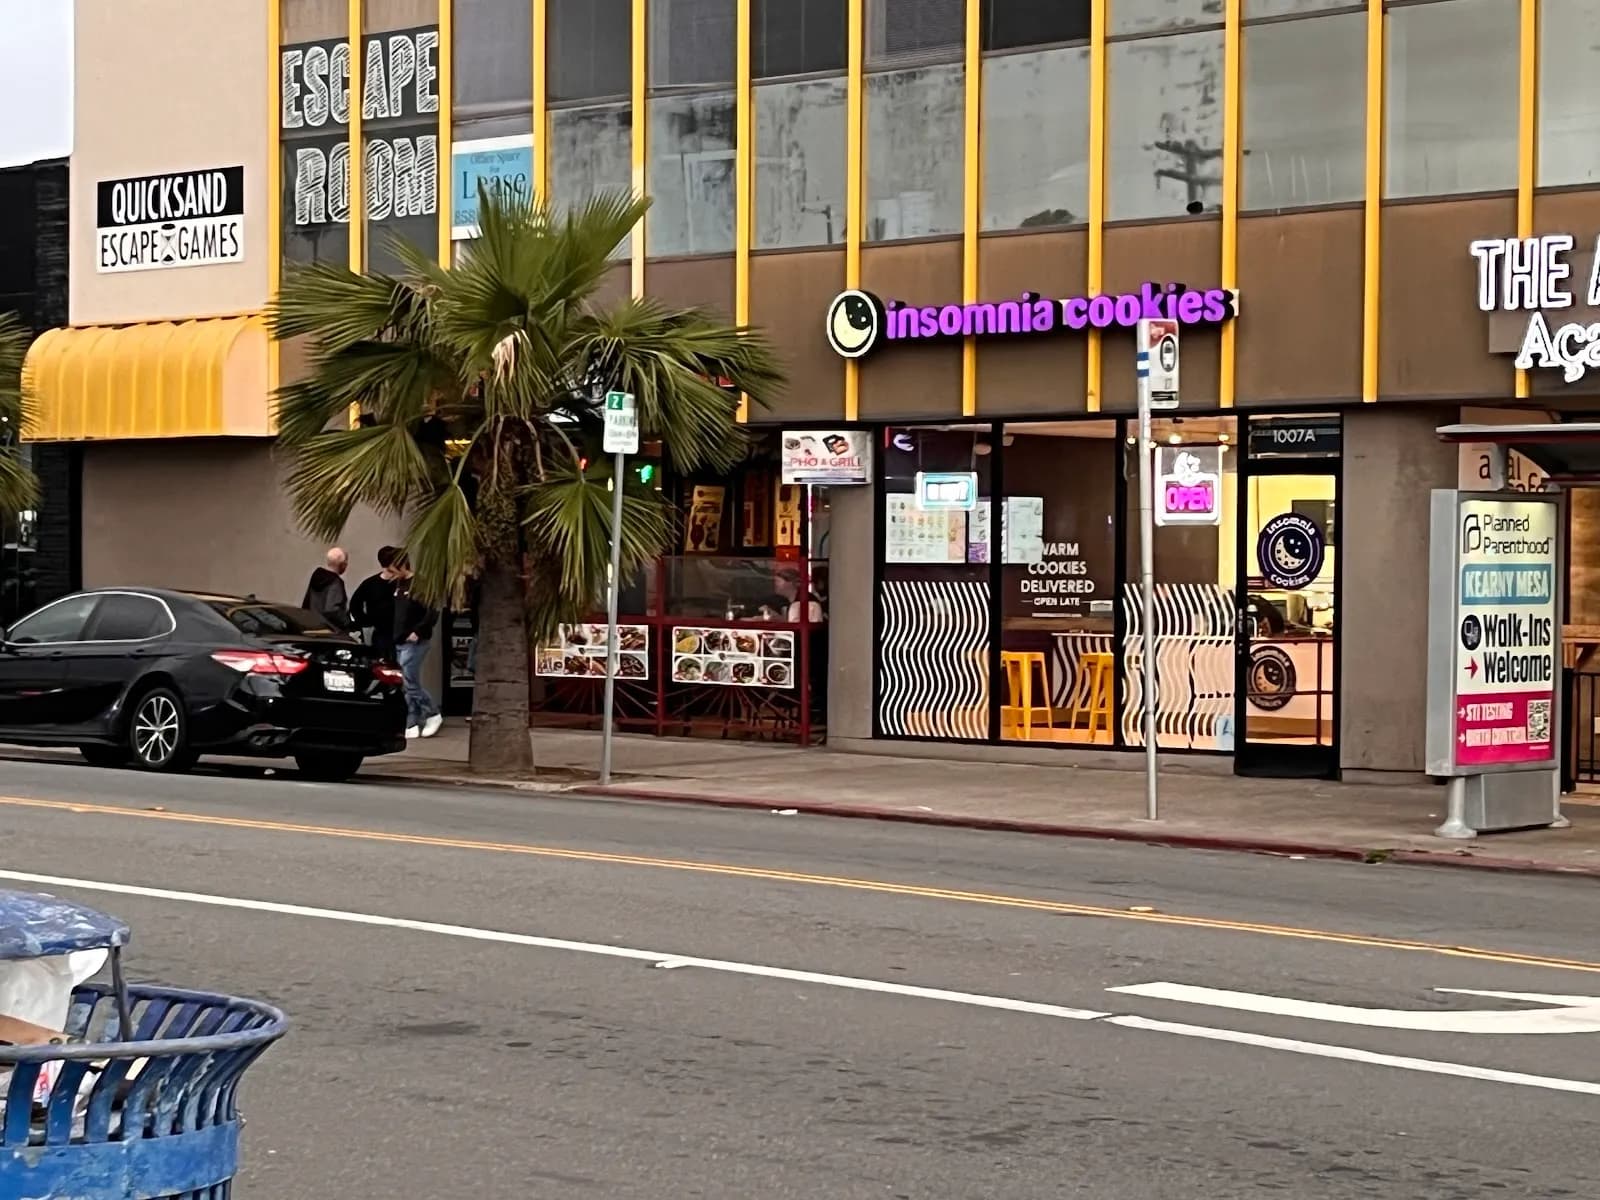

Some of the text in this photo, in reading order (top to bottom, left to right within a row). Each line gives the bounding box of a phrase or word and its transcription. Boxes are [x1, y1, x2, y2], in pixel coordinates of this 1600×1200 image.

[282, 31, 438, 128] ESCAPE
[295, 135, 437, 225] ROOM
[111, 171, 228, 224] QUICKSAND
[101, 222, 238, 268] ESCAPE GAMES
[1469, 235, 1574, 311] THE
[886, 282, 1226, 340] insomnia cookies
[1273, 428, 1317, 444] 1007A
[790, 457, 818, 467] PHO
[829, 456, 864, 467] GRILL
[1166, 486, 1213, 511] OPEN
[1483, 514, 1530, 532] Planned
[1483, 536, 1550, 554] Parenthood
[1028, 561, 1087, 575] COOKIES
[1020, 580, 1095, 593] DELIVERED
[1465, 570, 1549, 598] KEARNY MESA
[1033, 597, 1080, 606] OPEN LATE
[1483, 613, 1551, 648] Walk-Ins
[1483, 651, 1551, 683] Welcome
